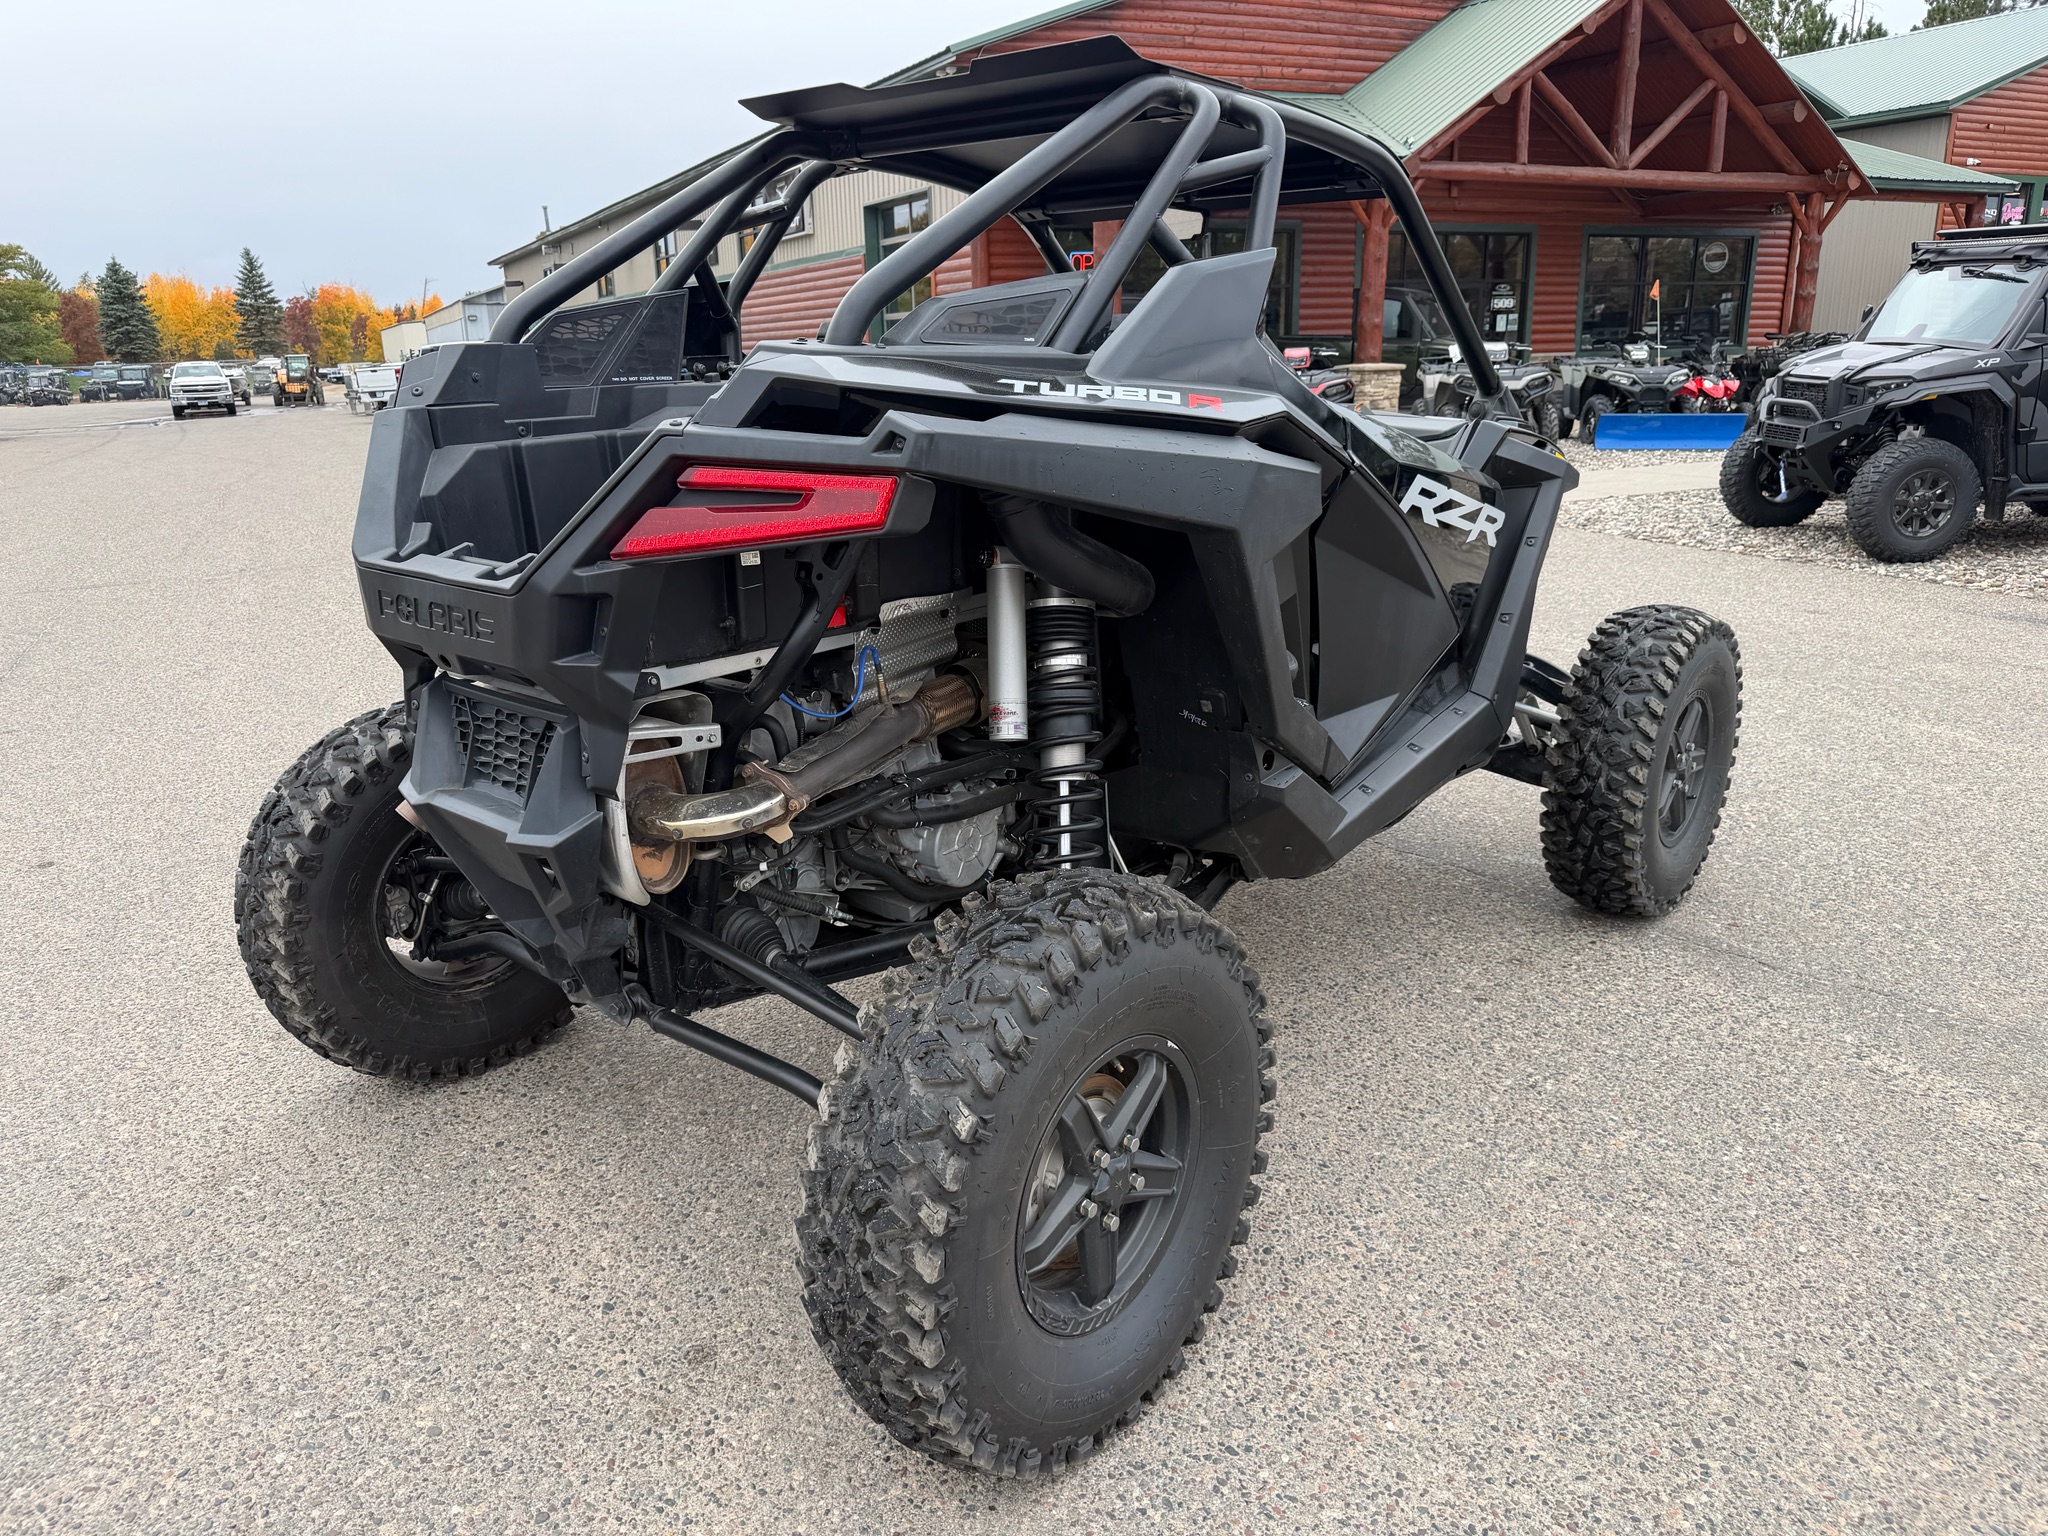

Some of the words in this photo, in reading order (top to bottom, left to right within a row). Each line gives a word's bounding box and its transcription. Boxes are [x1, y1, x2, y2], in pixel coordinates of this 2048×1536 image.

[1493, 298, 1514, 308] 509
[1973, 358, 2001, 369] XP
[997, 378, 1181, 405] TURBO
[1189, 393, 1224, 412] R
[1399, 473, 1506, 548] RZR
[378, 589, 495, 643] POLARIS
